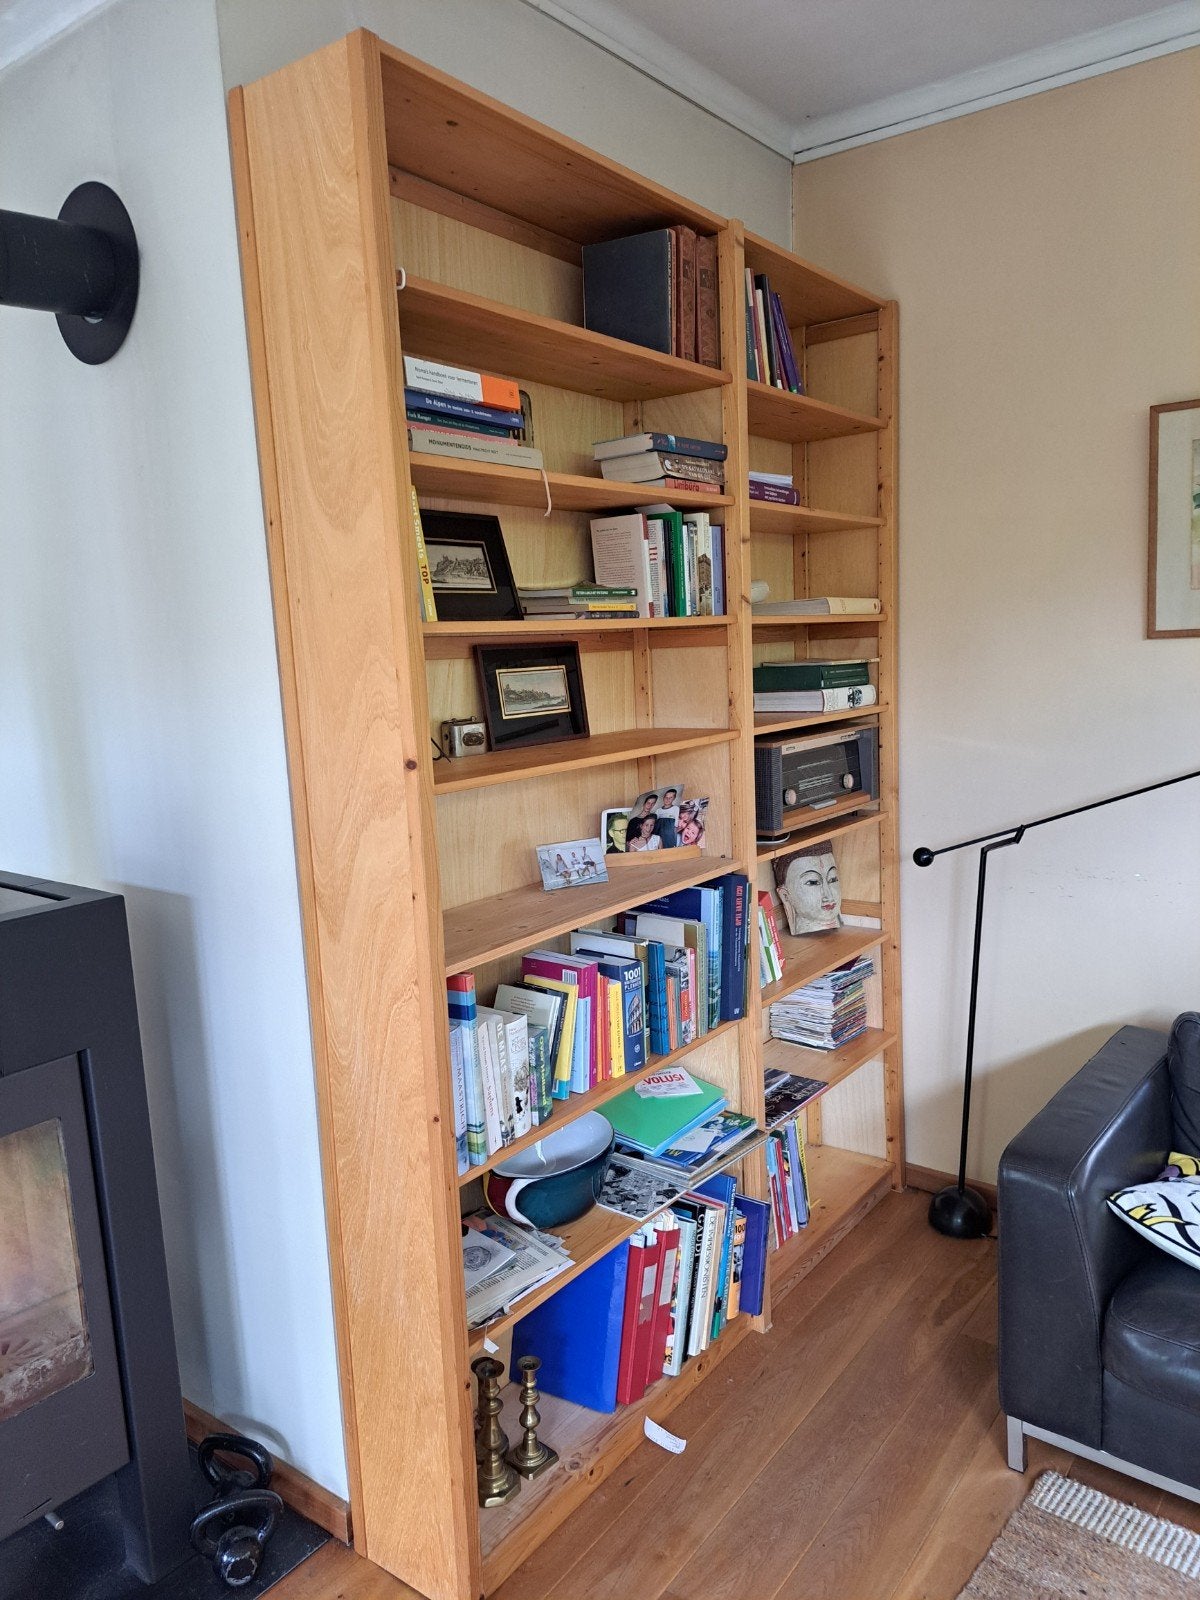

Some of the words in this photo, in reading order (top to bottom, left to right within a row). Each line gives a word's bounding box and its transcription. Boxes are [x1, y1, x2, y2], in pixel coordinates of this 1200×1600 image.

[425, 397, 432, 405] De
[433, 398, 447, 409] Alpen
[414, 520, 424, 559] Smeets
[420, 564, 429, 585] TOP
[624, 966, 640, 980] 1001
[497, 1022, 504, 1039] DE
[498, 1040, 507, 1073] MAAS
[732, 1184, 736, 1192] De
[709, 1216, 716, 1227] DE
[701, 1228, 714, 1298] IMPRESSIONISTEN
